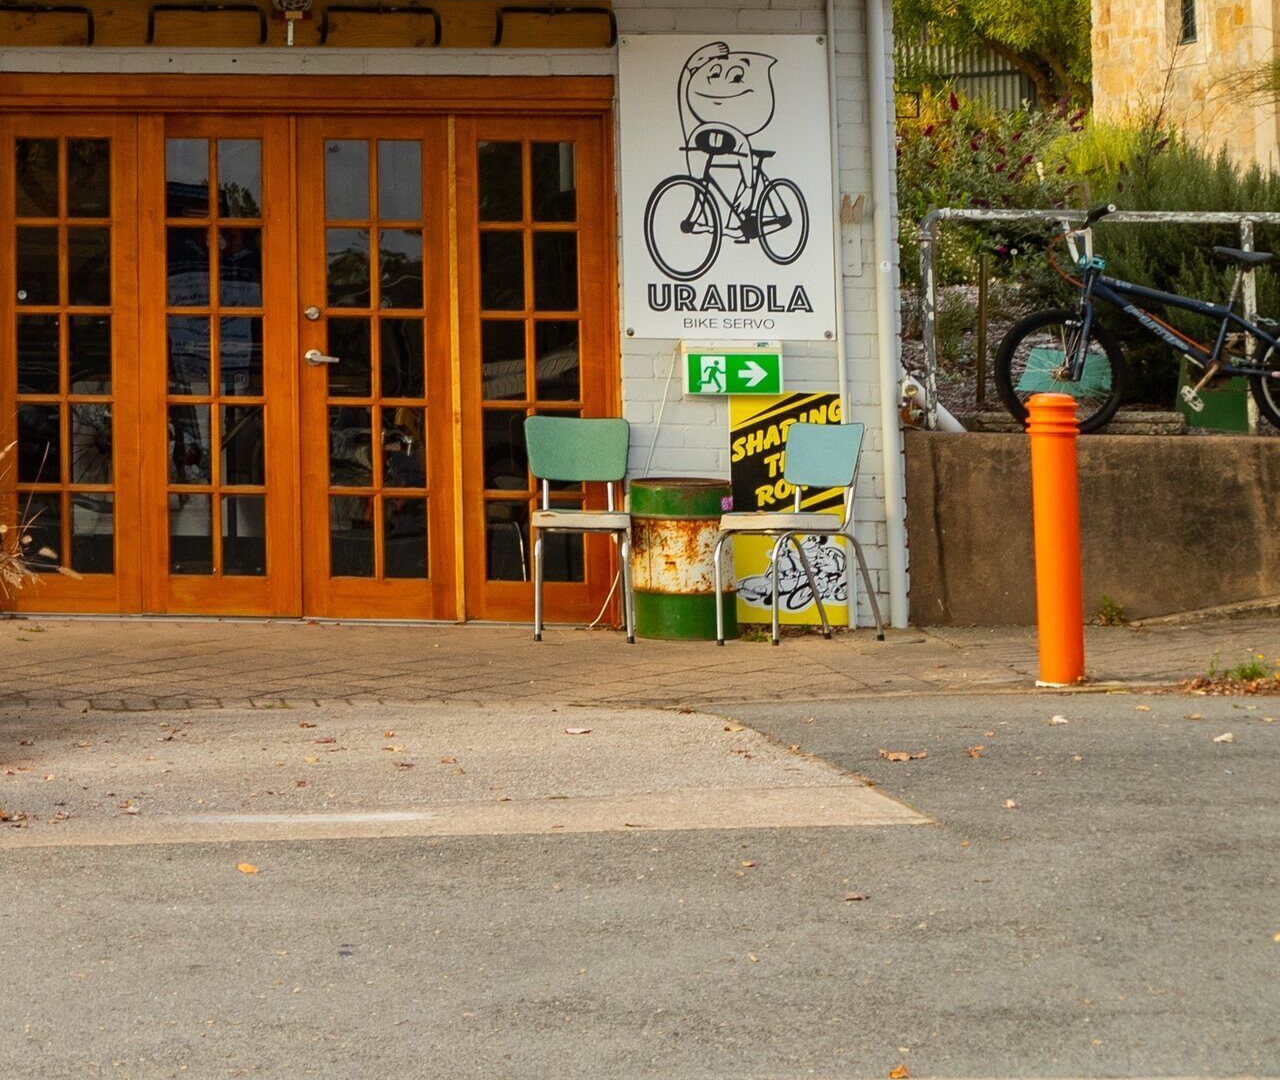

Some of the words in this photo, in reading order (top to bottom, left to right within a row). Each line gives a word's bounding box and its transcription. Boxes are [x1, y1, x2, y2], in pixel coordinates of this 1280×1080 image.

[647, 283, 814, 313] URAIDLA
[683, 318, 718, 329] BIKE
[723, 318, 775, 330] SERVO
[755, 478, 808, 507] RO
